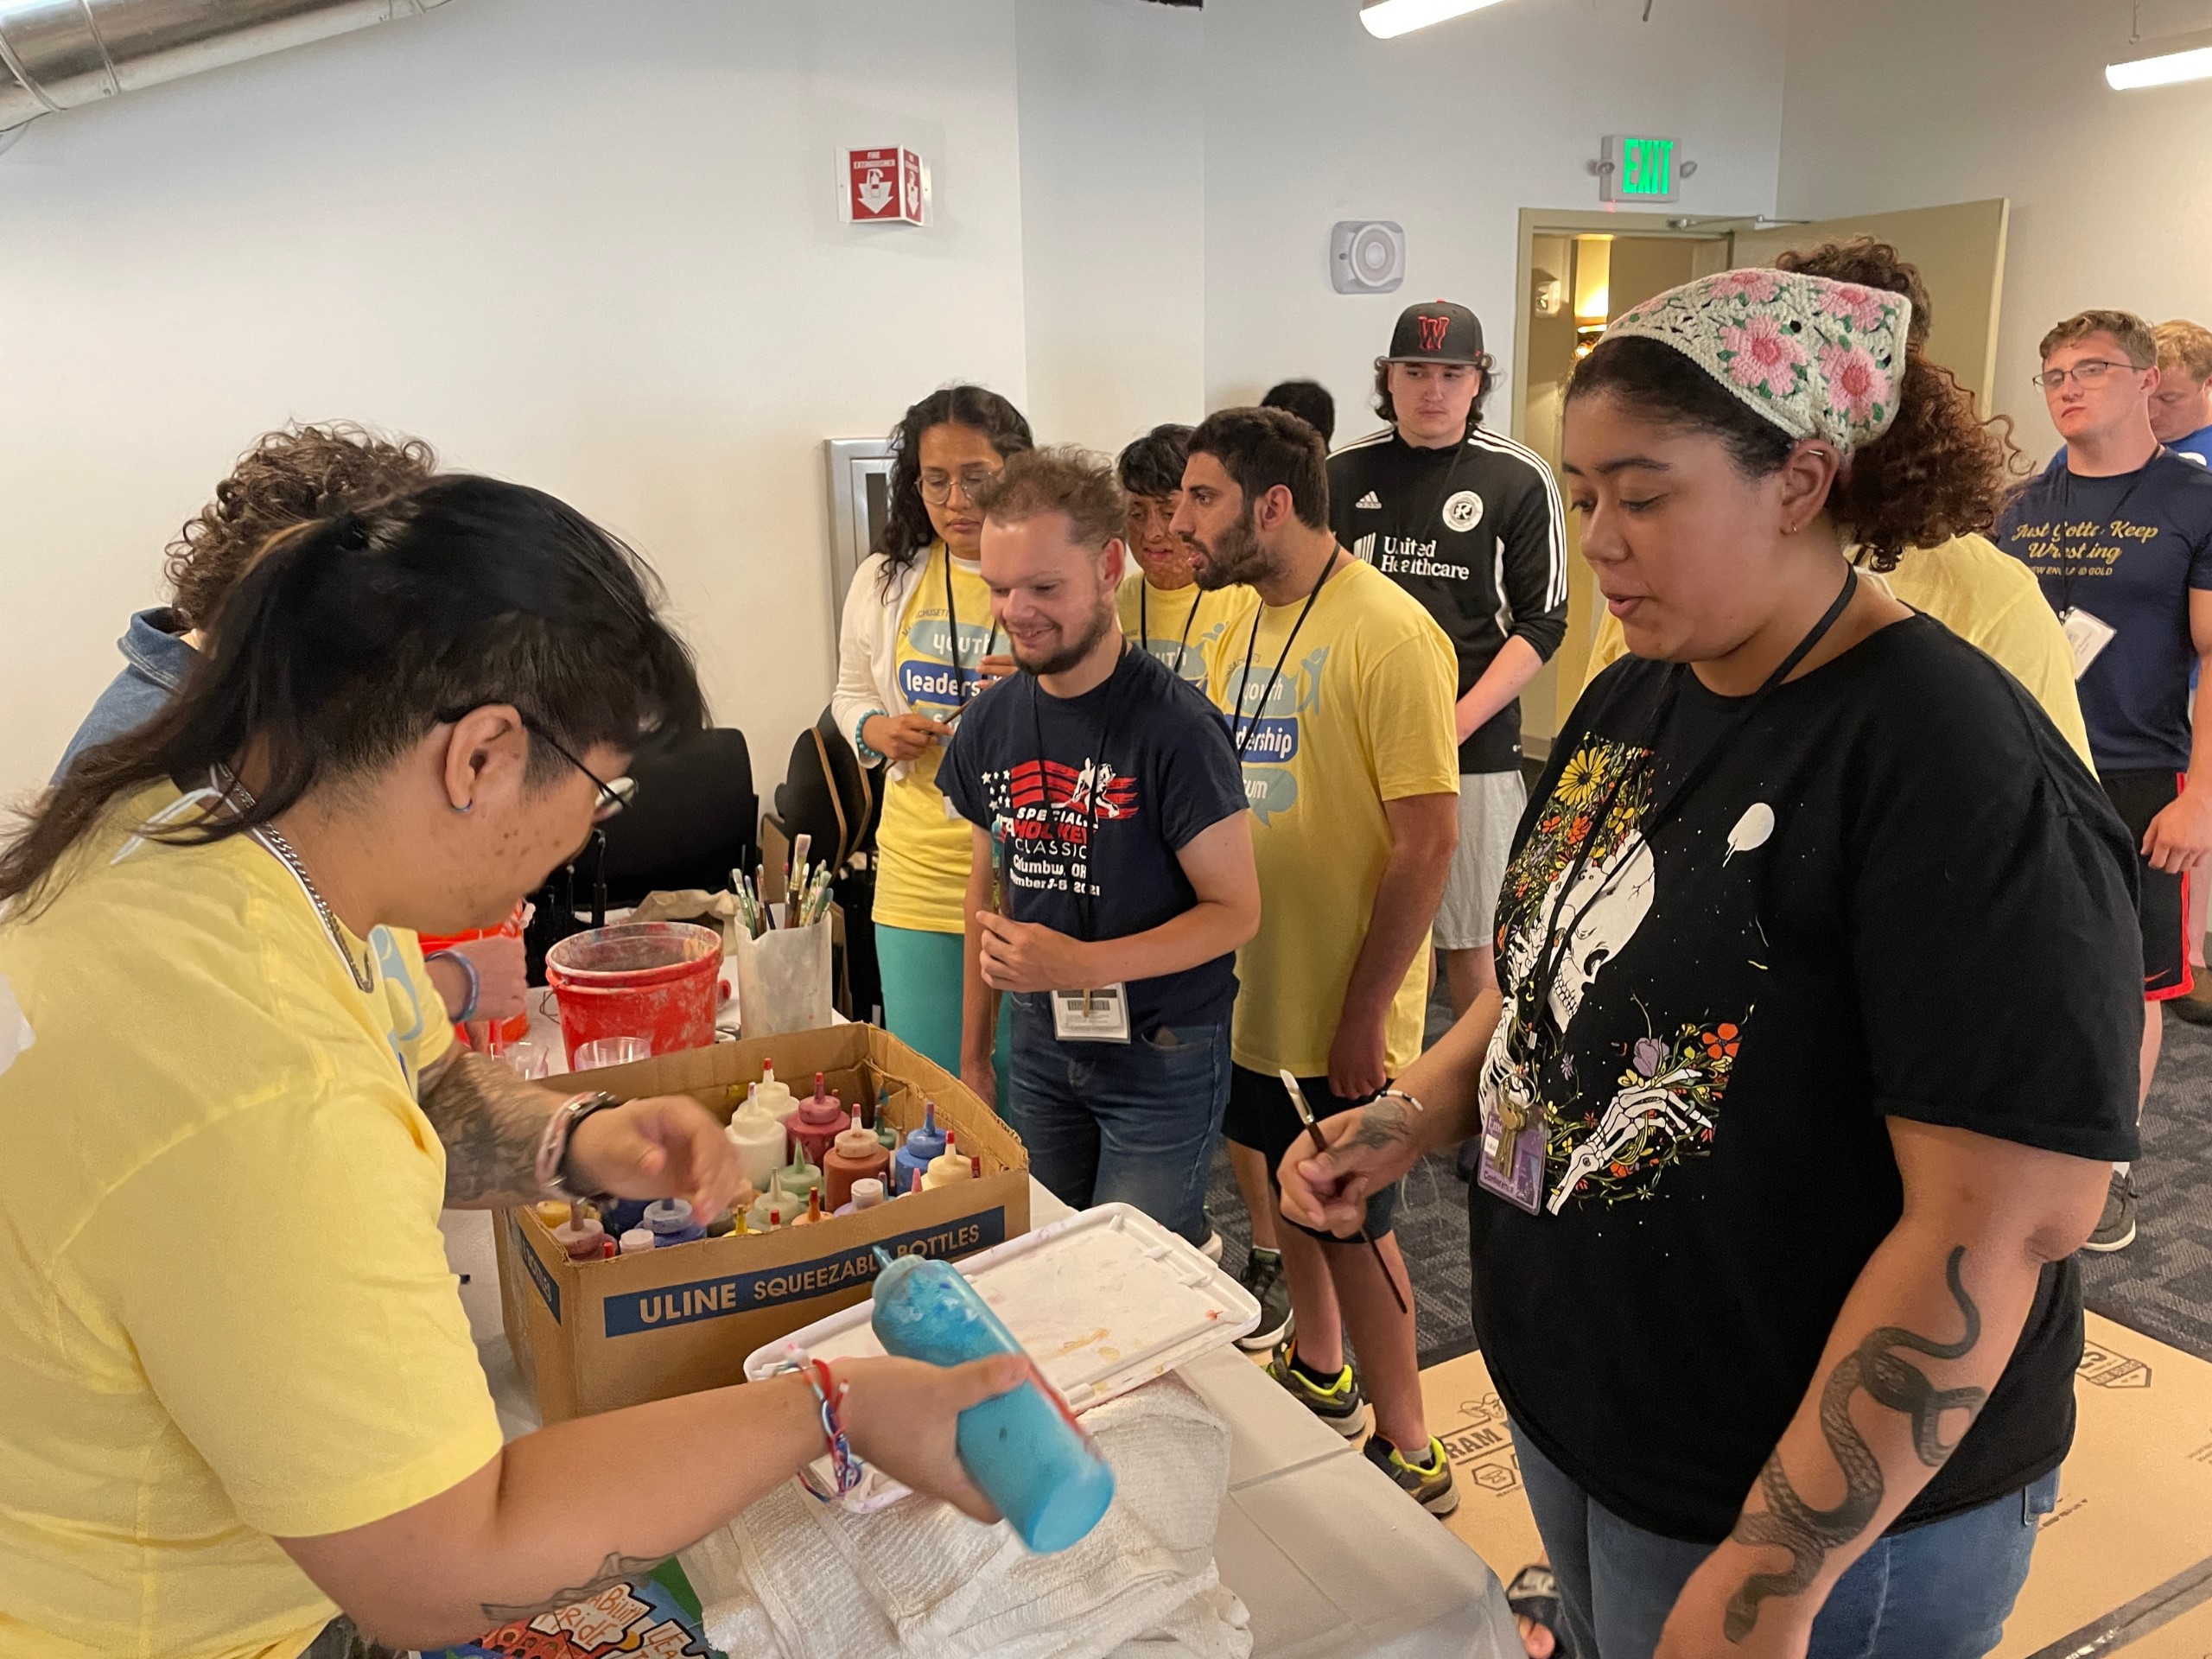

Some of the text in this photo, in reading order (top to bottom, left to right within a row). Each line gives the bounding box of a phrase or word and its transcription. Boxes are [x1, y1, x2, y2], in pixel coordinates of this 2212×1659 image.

[1623, 138, 1674, 194] EXIT
[1417, 315, 1450, 351] W
[2012, 522, 2050, 541] Just
[2111, 520, 2158, 543] Keep
[1384, 536, 1437, 557] United
[2029, 542, 2122, 565] Wrsting
[2088, 567, 2113, 575] GOLD
[906, 669, 982, 696] leaders
[1236, 726, 1293, 759] dership
[1014, 838, 1087, 860] CLASSIC
[1071, 862, 1087, 879] OH
[639, 1224, 981, 1324] ULINE SQUEEZABL BOTTLES
[1445, 1428, 1503, 1459] RAM
